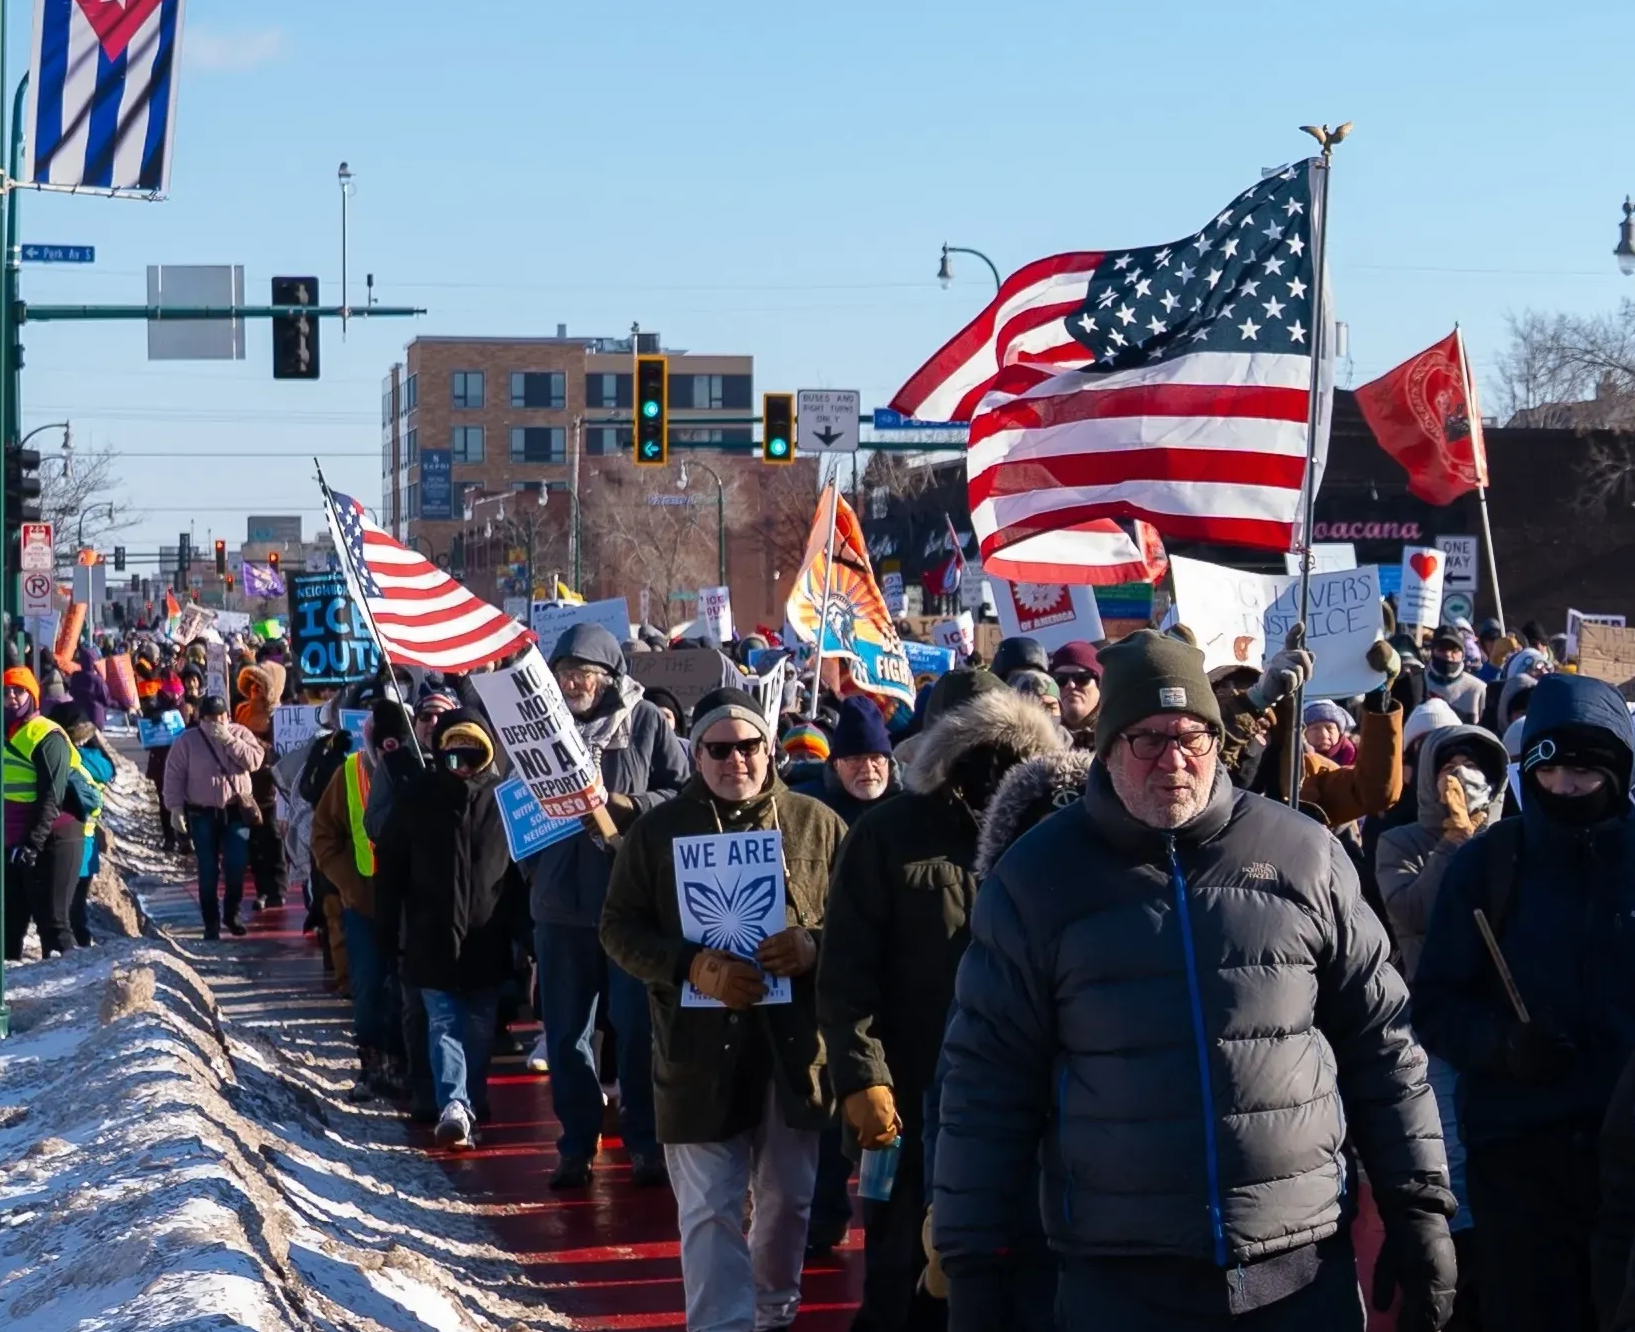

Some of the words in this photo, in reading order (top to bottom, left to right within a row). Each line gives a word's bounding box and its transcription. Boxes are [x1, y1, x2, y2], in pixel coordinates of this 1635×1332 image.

[803, 394, 831, 403] BUSES
[836, 394, 854, 402] AND
[1314, 519, 1423, 540] oacana
[1444, 541, 1470, 554] ONE
[1445, 556, 1471, 568] WAY
[298, 597, 373, 638] ICE
[1034, 611, 1076, 629] AMERICA
[1307, 606, 1370, 639] ICE
[511, 664, 542, 698] NO
[277, 706, 306, 726] THE
[514, 747, 553, 780] NO
[512, 802, 535, 820] WITH
[679, 842, 716, 869] WE
[728, 838, 776, 865] ARE
